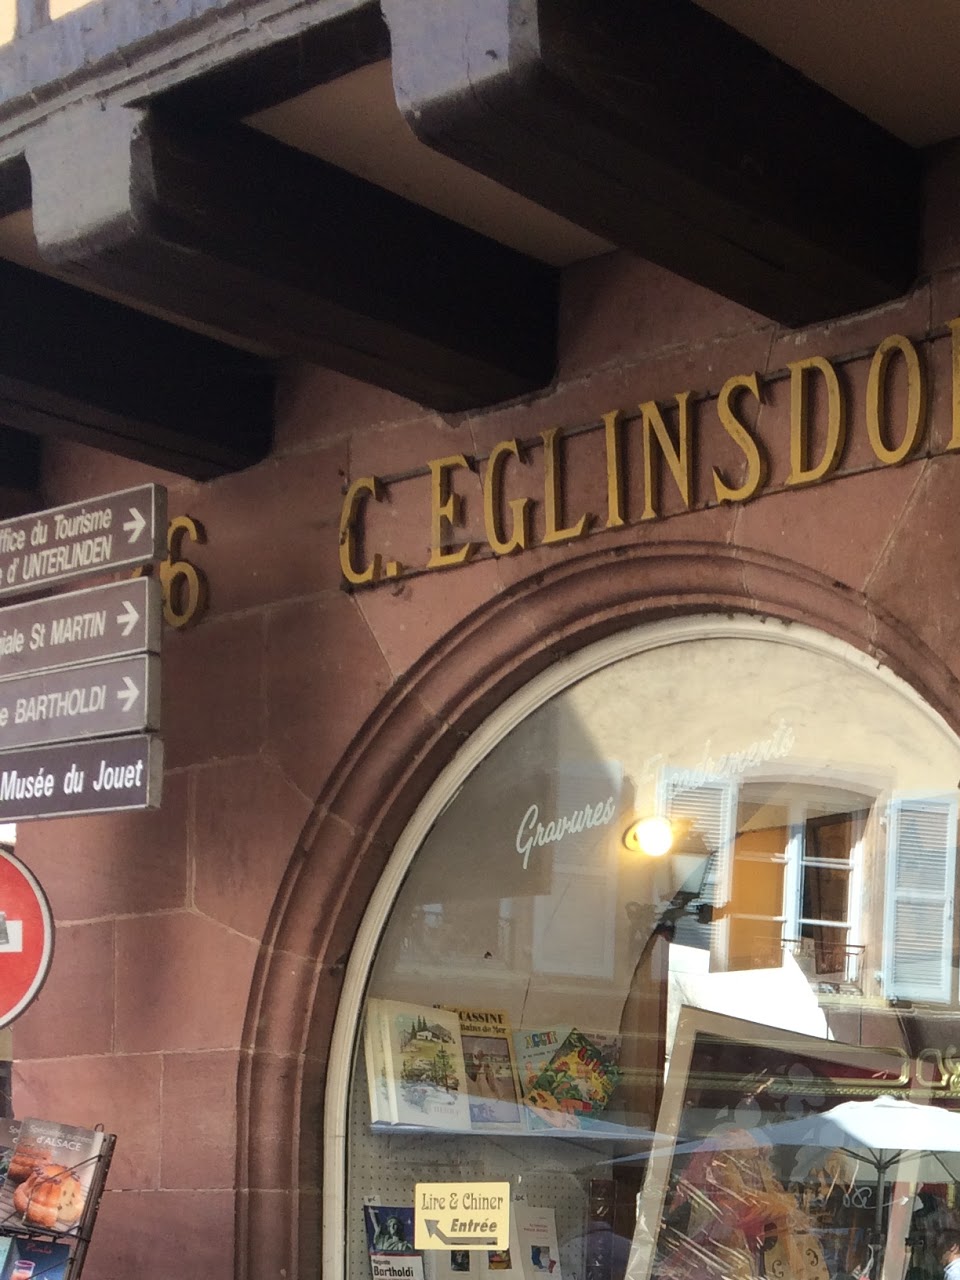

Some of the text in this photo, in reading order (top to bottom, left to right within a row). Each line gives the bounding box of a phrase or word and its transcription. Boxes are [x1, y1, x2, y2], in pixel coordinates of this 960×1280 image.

[31, 520, 48, 546] du
[54, 508, 112, 541] Tourisme
[339, 476, 397, 585] C.
[22, 534, 113, 581] UNTERLINDEN
[30, 623, 46, 650] St
[50, 610, 106, 646] MARTIN
[15, 685, 107, 724] BARTHOLDI
[0, 759, 143, 800] Musée du Jouet
[516, 796, 615, 869] Gravures
[36, 1135, 82, 1152] d'ALSACE
[421, 1193, 504, 1211] Lire & Chiner
[450, 1217, 498, 1233] Entrée
[374, 1266, 414, 1278] Bartholdi
